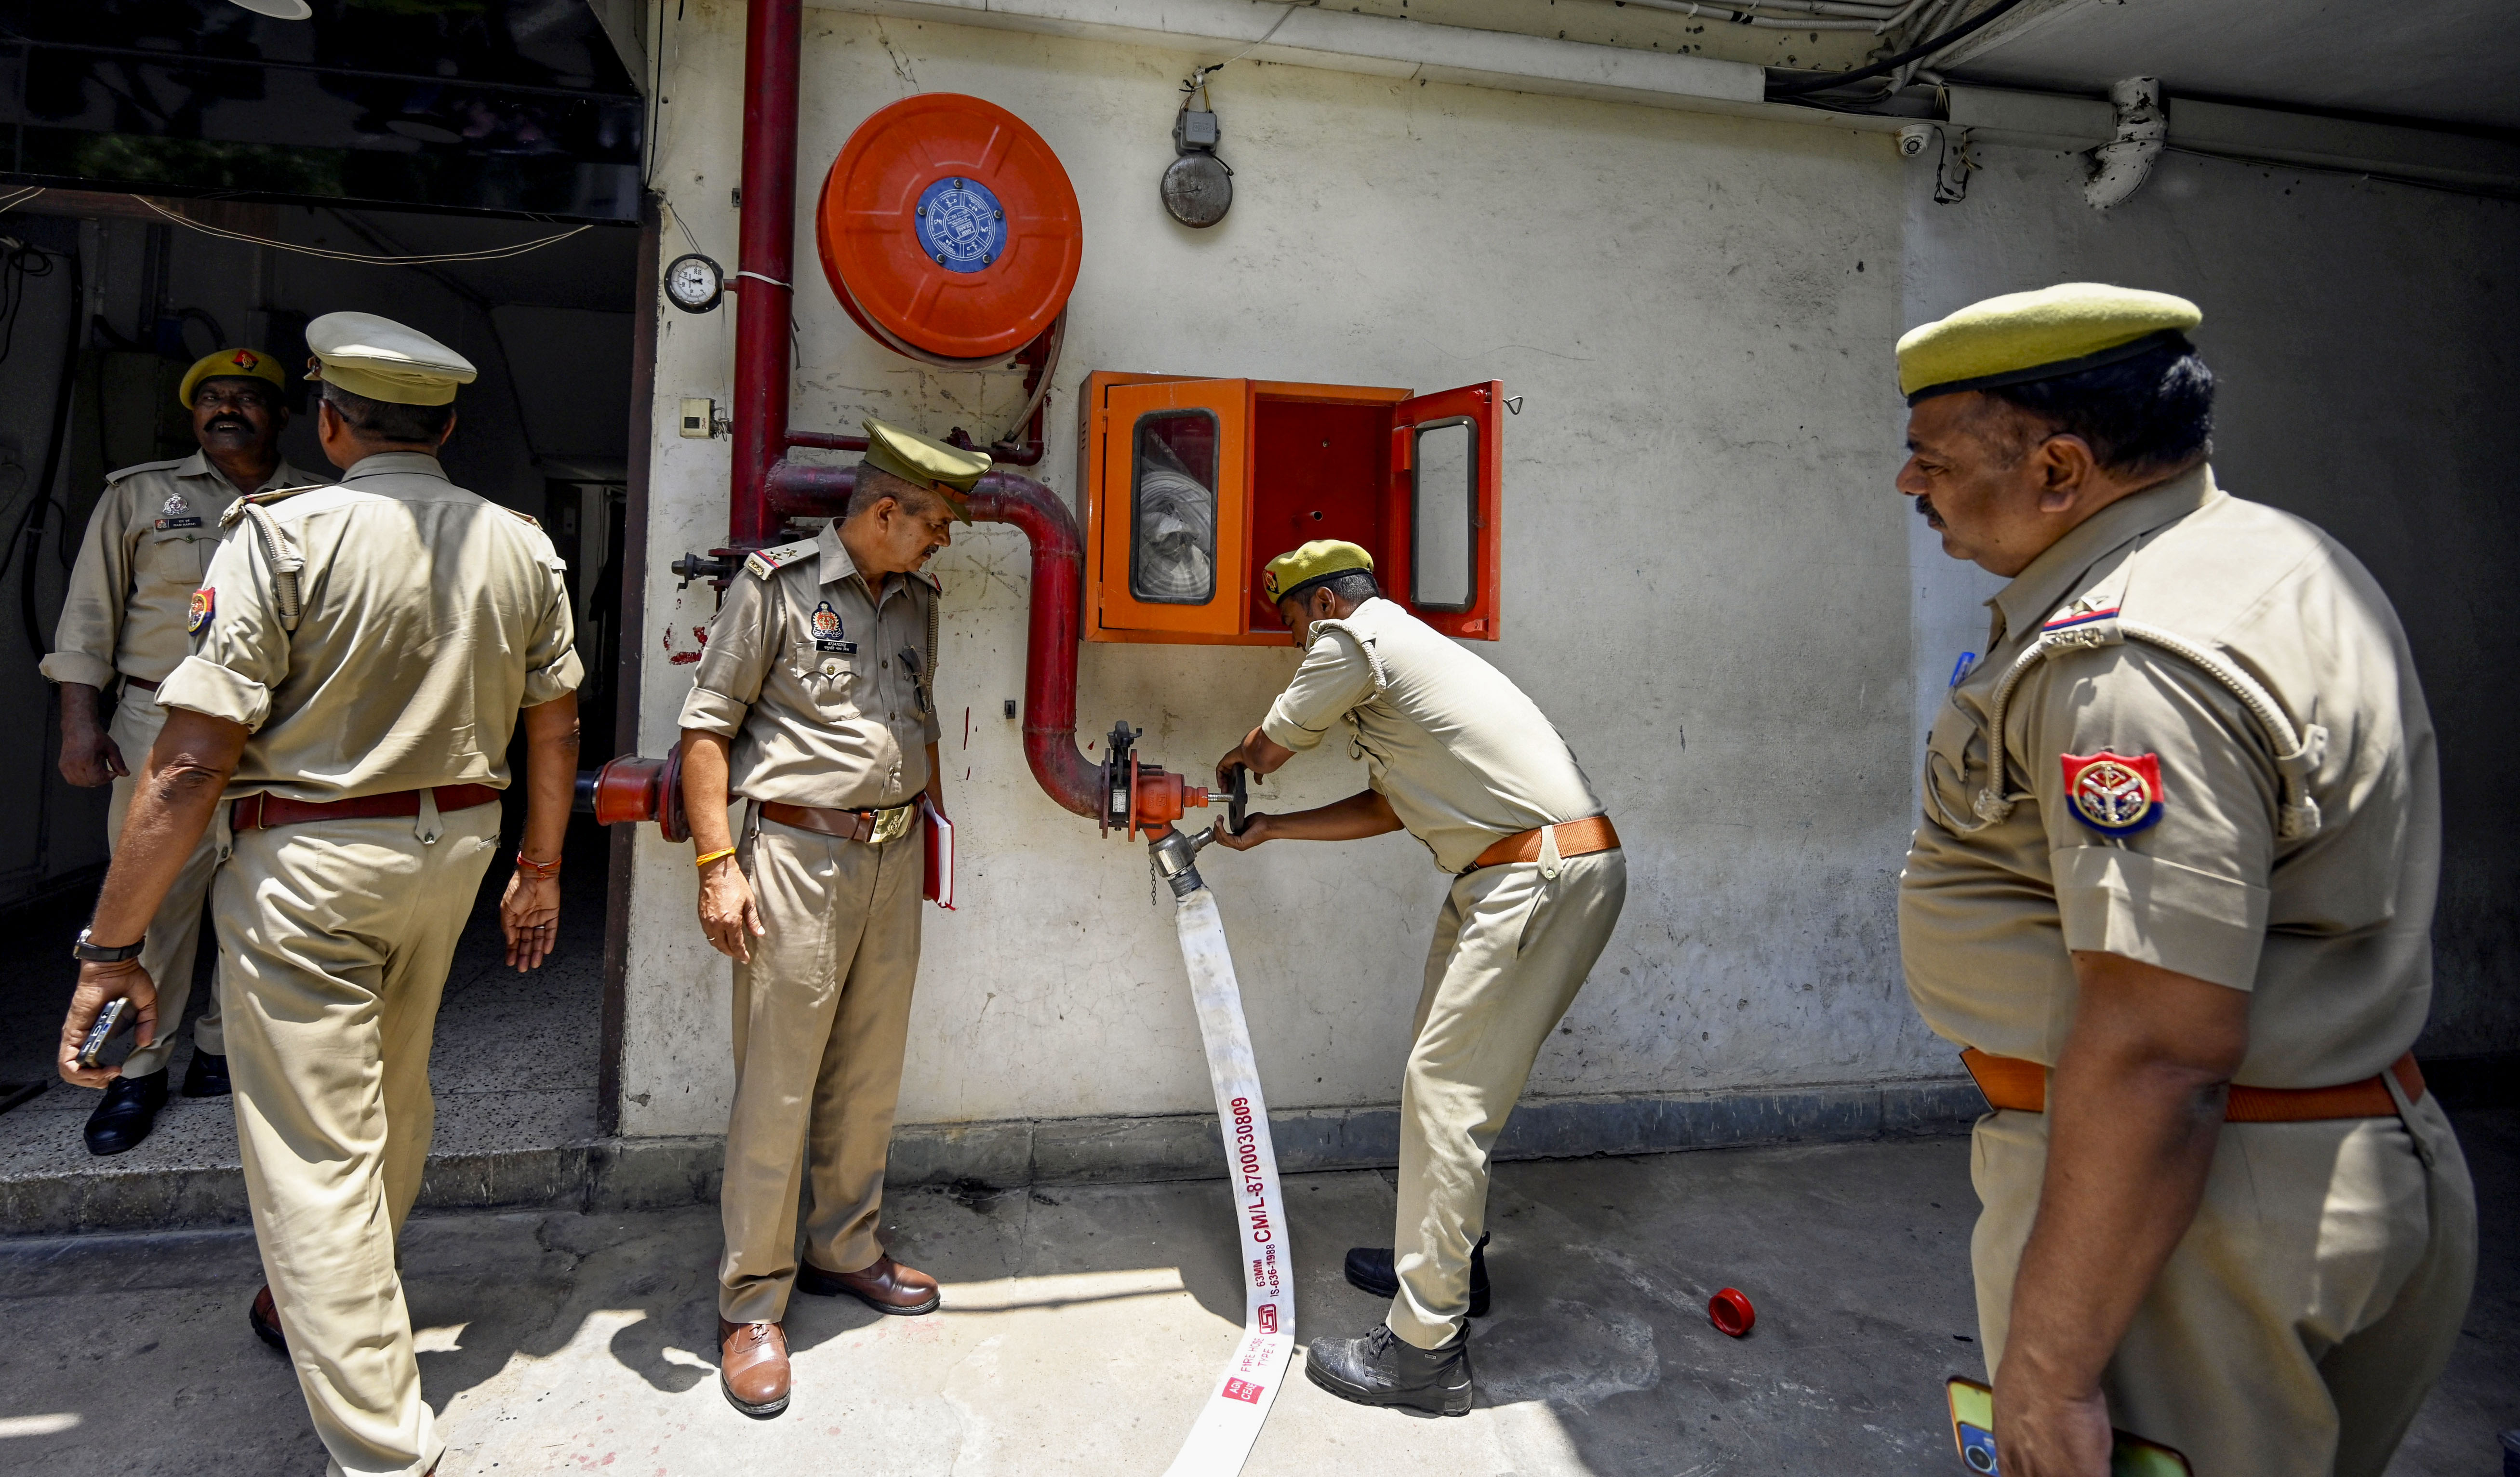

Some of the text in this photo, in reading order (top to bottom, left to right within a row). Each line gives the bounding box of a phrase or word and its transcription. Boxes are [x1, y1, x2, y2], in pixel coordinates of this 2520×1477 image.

[961, 228, 973, 236] AGNI
[1231, 1097, 1271, 1243] CM/L-8700030809
[1253, 1259, 1266, 1287] 63MM
[1266, 1244, 1280, 1297] IS-636-1988
[1241, 1338, 1265, 1372] FIRE HOSE
[1257, 1349, 1274, 1366] TYPE
[1229, 1380, 1243, 1394] AGNI
[1241, 1383, 1257, 1400] CEASE
